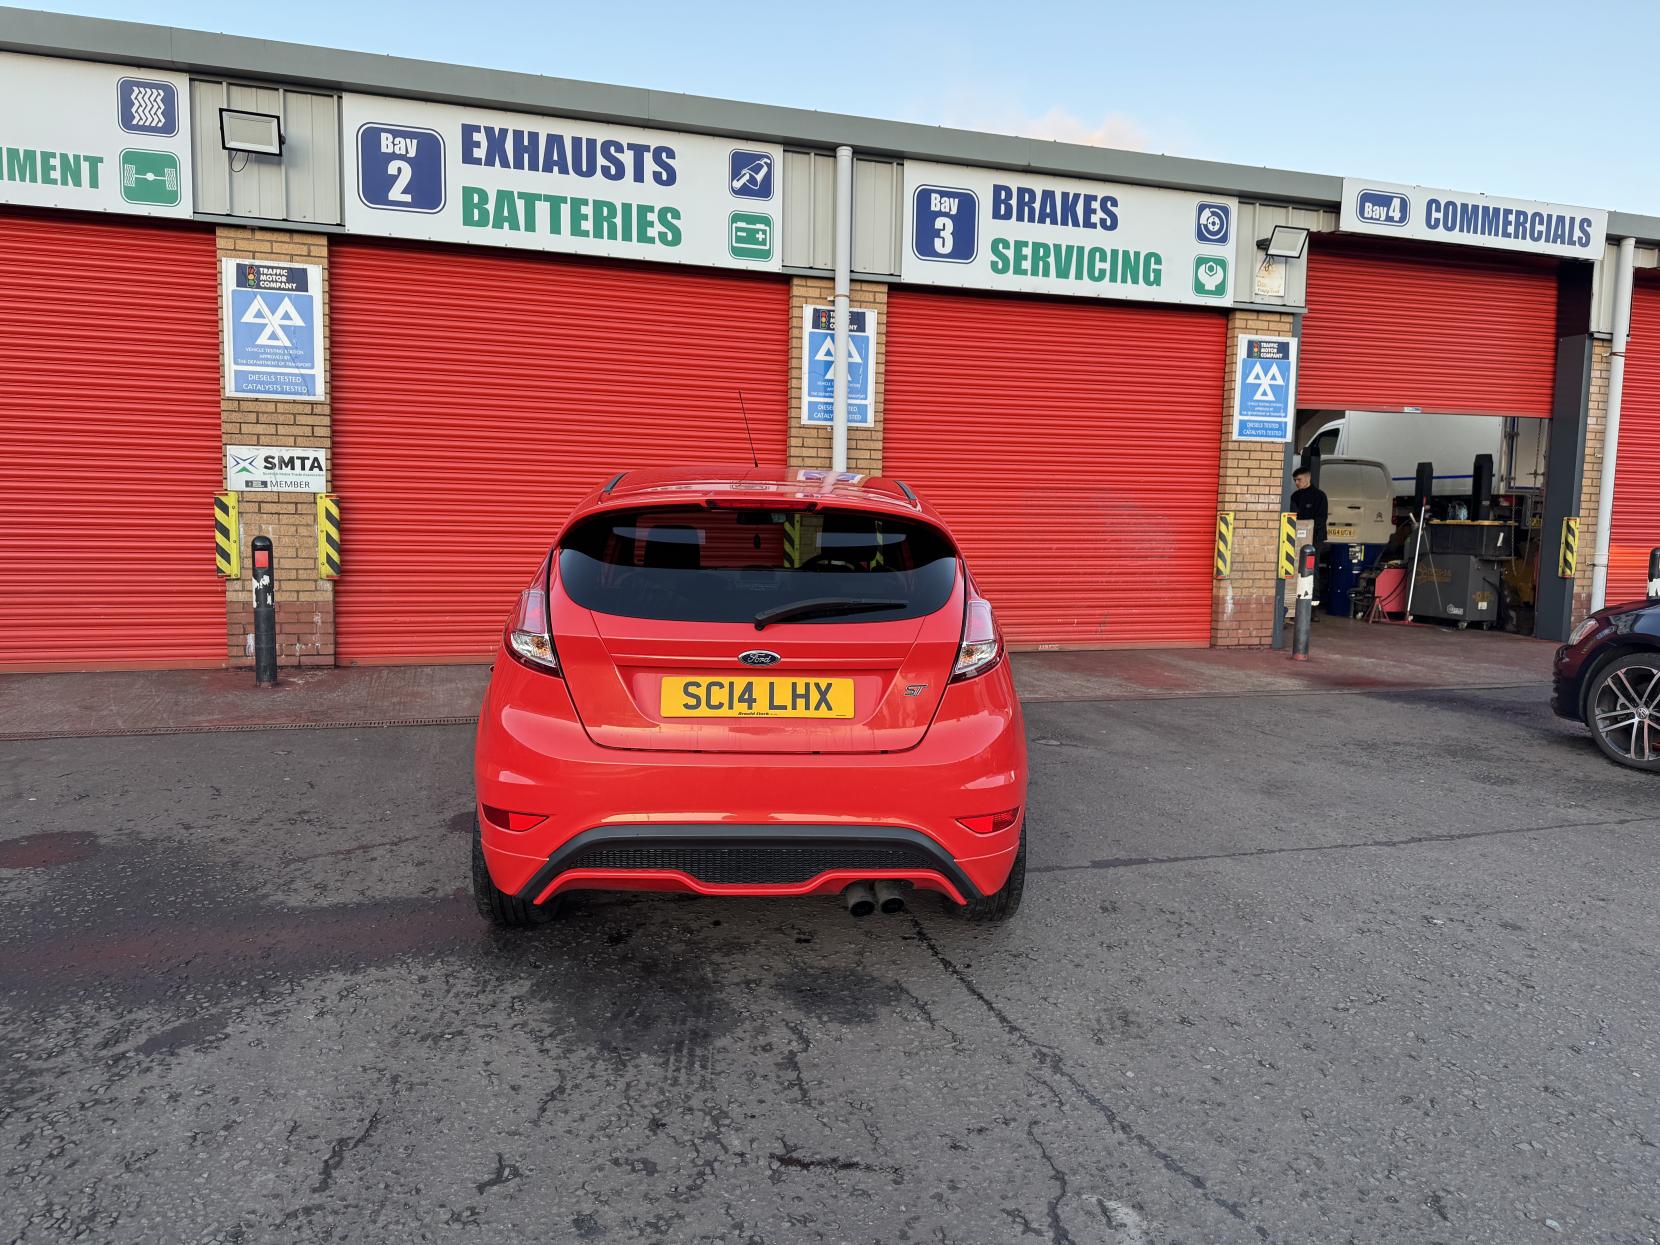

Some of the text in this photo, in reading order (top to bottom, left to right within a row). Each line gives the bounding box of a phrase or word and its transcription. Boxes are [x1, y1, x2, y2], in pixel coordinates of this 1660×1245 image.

[380, 132, 418, 159] Bay
[460, 122, 677, 187] EXHAUSTS
[0, 146, 104, 189] MENT
[387, 159, 412, 203] 2
[461, 185, 682, 248] BATTERIES
[930, 192, 959, 217] Bay
[992, 183, 1119, 232] BRAKES
[933, 217, 955, 255] 3
[1425, 198, 1593, 248] COMMERCIALS
[259, 267, 288, 276] TRAFFIC
[990, 237, 1162, 288] SERVICING
[260, 274, 287, 282] MOTOR
[260, 281, 297, 290] COMPANY
[242, 383, 308, 393] CATALYSTS TESTED
[248, 374, 302, 383] DIESELS TESTED
[263, 454, 324, 472] SMTA
[270, 480, 310, 488] MEMBER
[747, 652, 772, 662] Ford
[682, 681, 833, 712] SC14 LHX
[904, 684, 928, 696] ST
